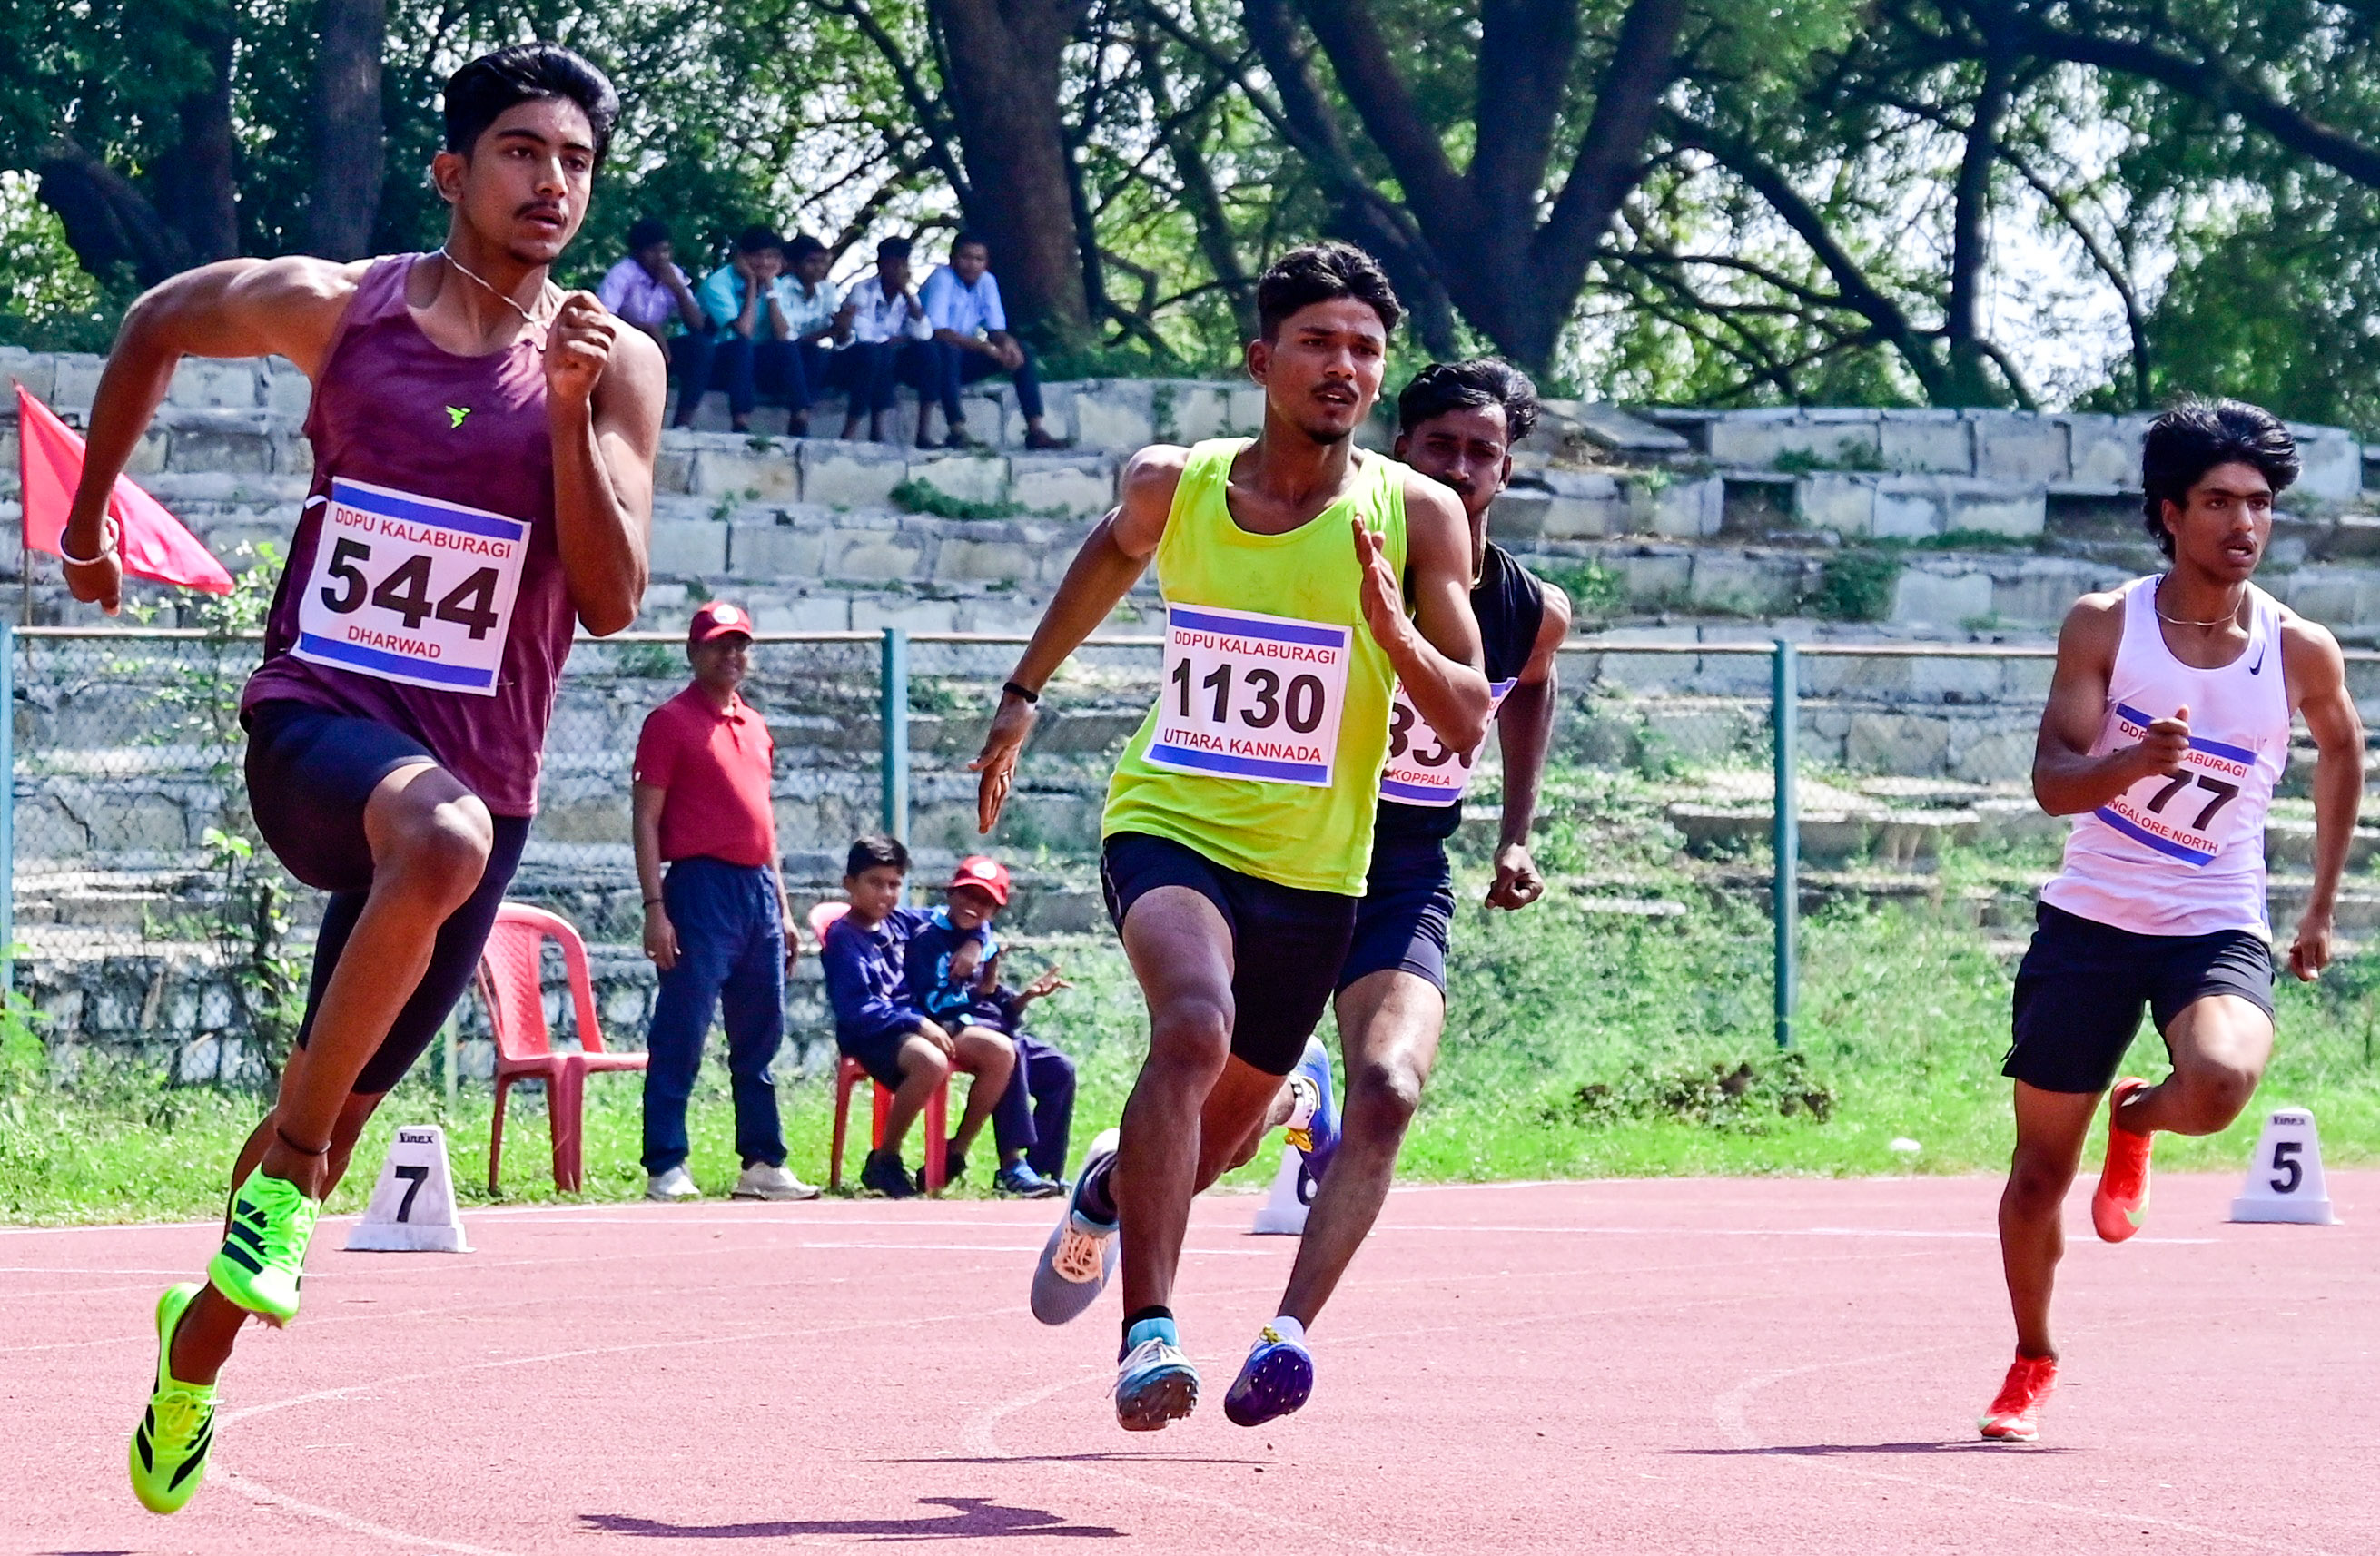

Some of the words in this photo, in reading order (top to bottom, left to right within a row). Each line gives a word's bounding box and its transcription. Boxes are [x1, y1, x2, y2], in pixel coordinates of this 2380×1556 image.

[335, 507, 376, 532] DDPU
[380, 520, 511, 559] KALABURAGI
[321, 537, 500, 641] 544
[347, 625, 442, 659] DHARWAD
[1174, 631, 1215, 650] DDPU
[1220, 637, 1337, 665] KALABURAGI
[1171, 657, 1326, 734] 1130
[1163, 727, 1224, 752] UTTARA
[1229, 738, 1322, 763] KANNADA
[2184, 752, 2248, 779] ABURAGI
[1392, 770, 1451, 786] KOPPALA
[2159, 767, 2240, 832] 77
[2108, 798, 2170, 838] NGALORE
[2171, 829, 2219, 854] NORTH
[394, 1165, 430, 1224] 7
[2269, 1141, 2303, 1195] 5
